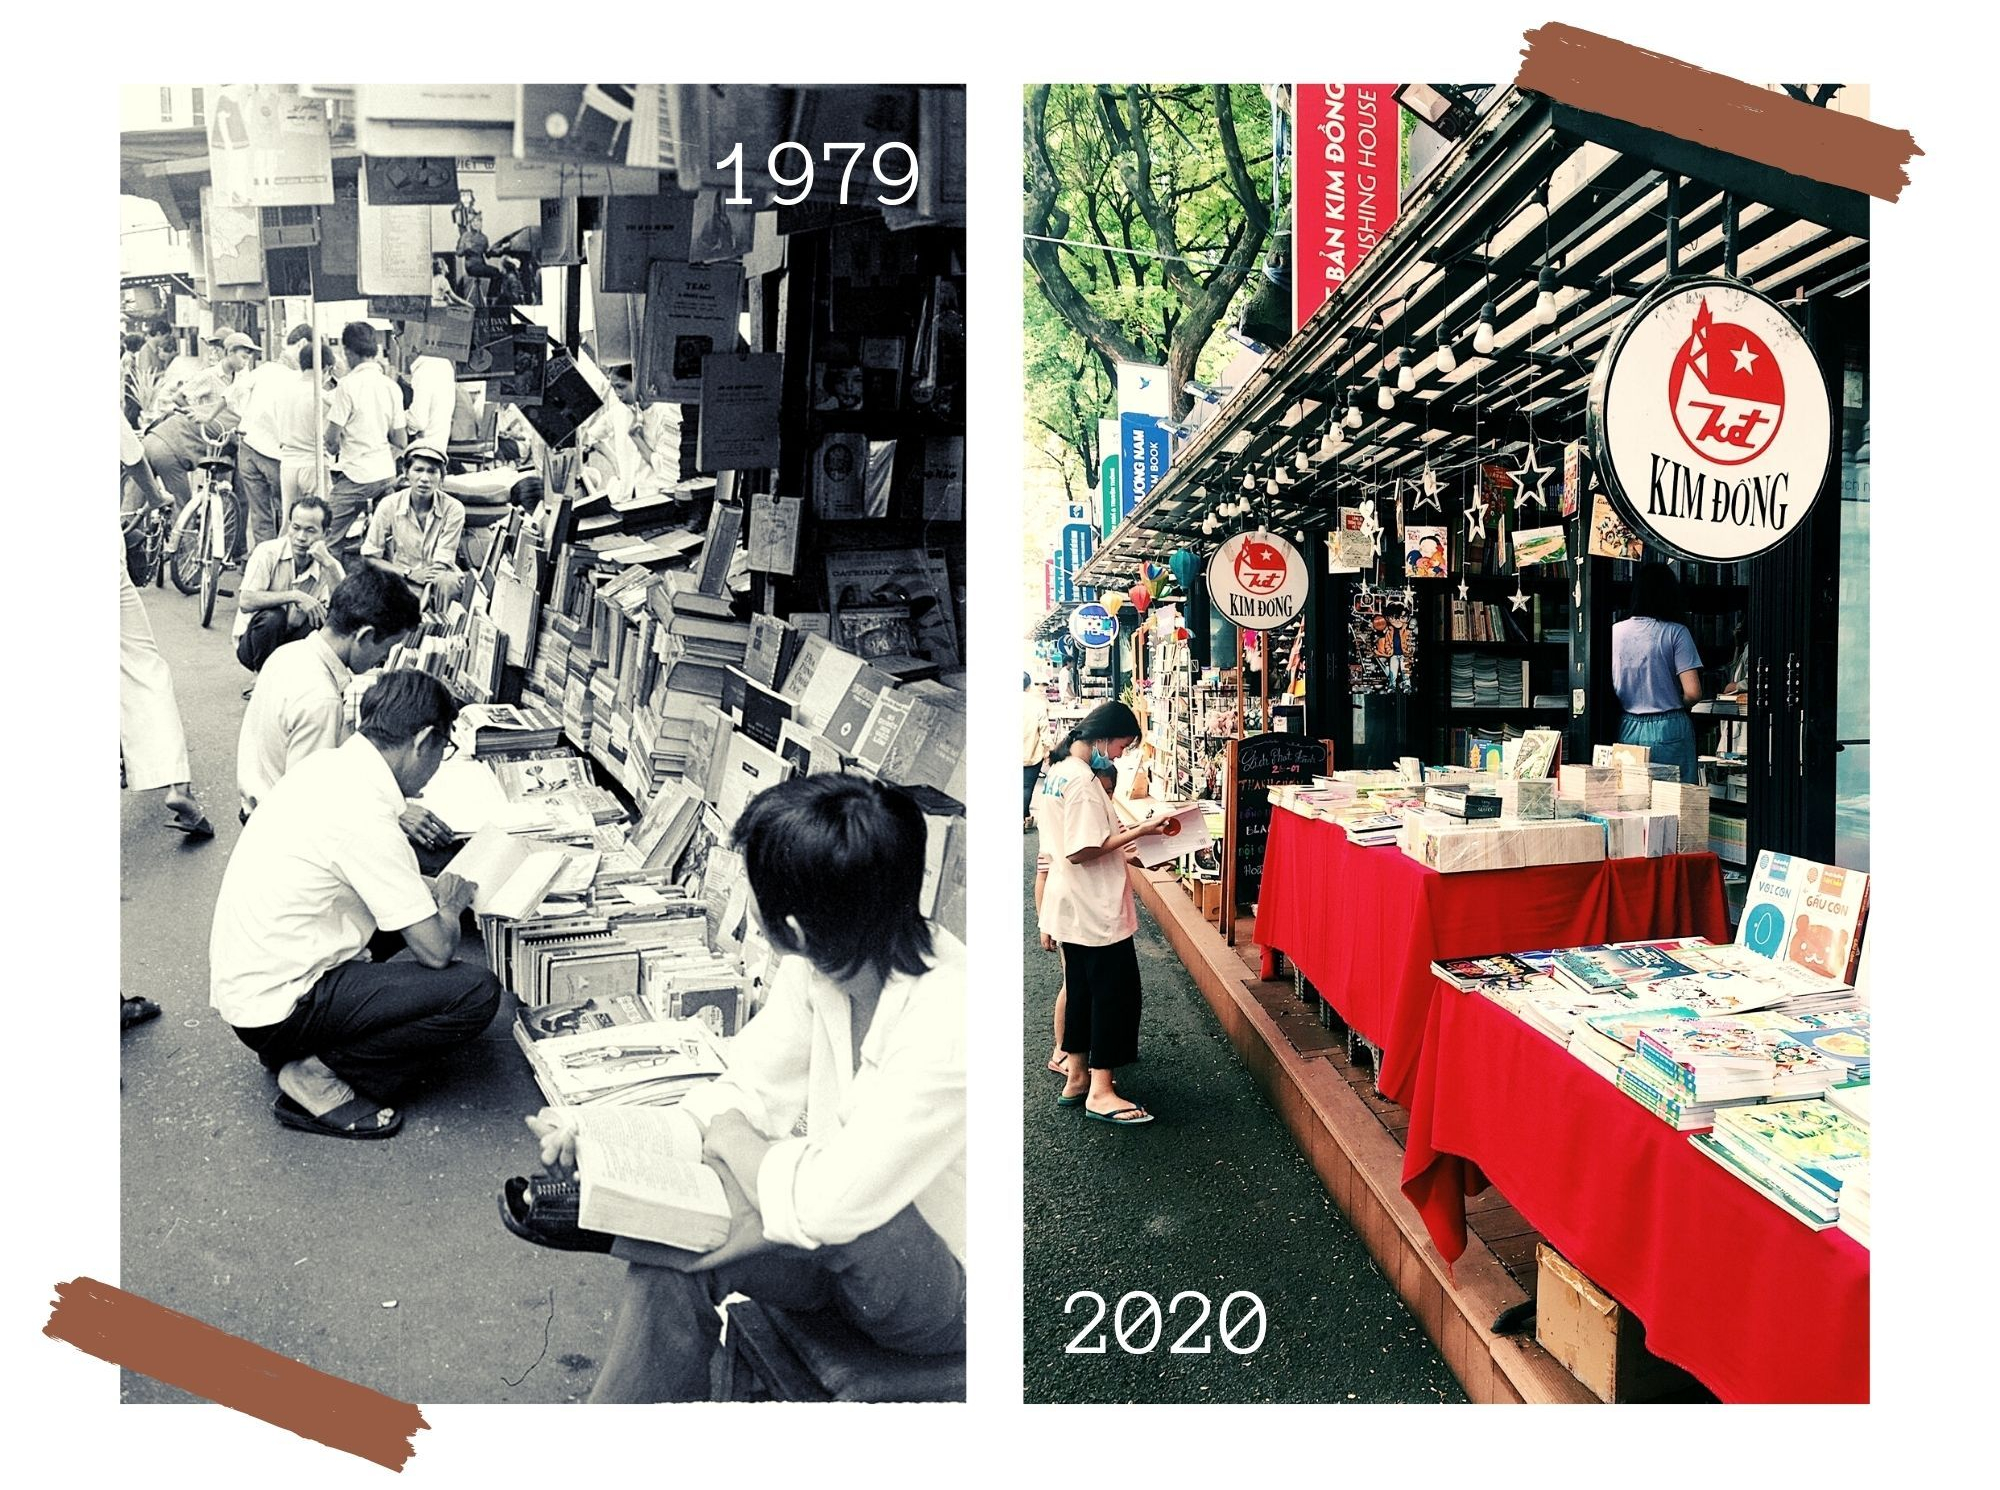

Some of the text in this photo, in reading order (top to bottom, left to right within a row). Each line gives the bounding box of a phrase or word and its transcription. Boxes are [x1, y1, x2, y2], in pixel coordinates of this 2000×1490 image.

[1357, 88, 1377, 168] HOUSE
[1325, 170, 1346, 221] KIM
[1319, 227, 1346, 283] BẢN
[1132, 429, 1145, 460] NAM
[1150, 442, 1159, 472] BOOK
[1647, 453, 1789, 530] KIM ĐỒNG
[1229, 593, 1293, 618] KIM ĐỒNG
[1774, 883, 1792, 900] CON
[1828, 899, 1850, 918] CON
